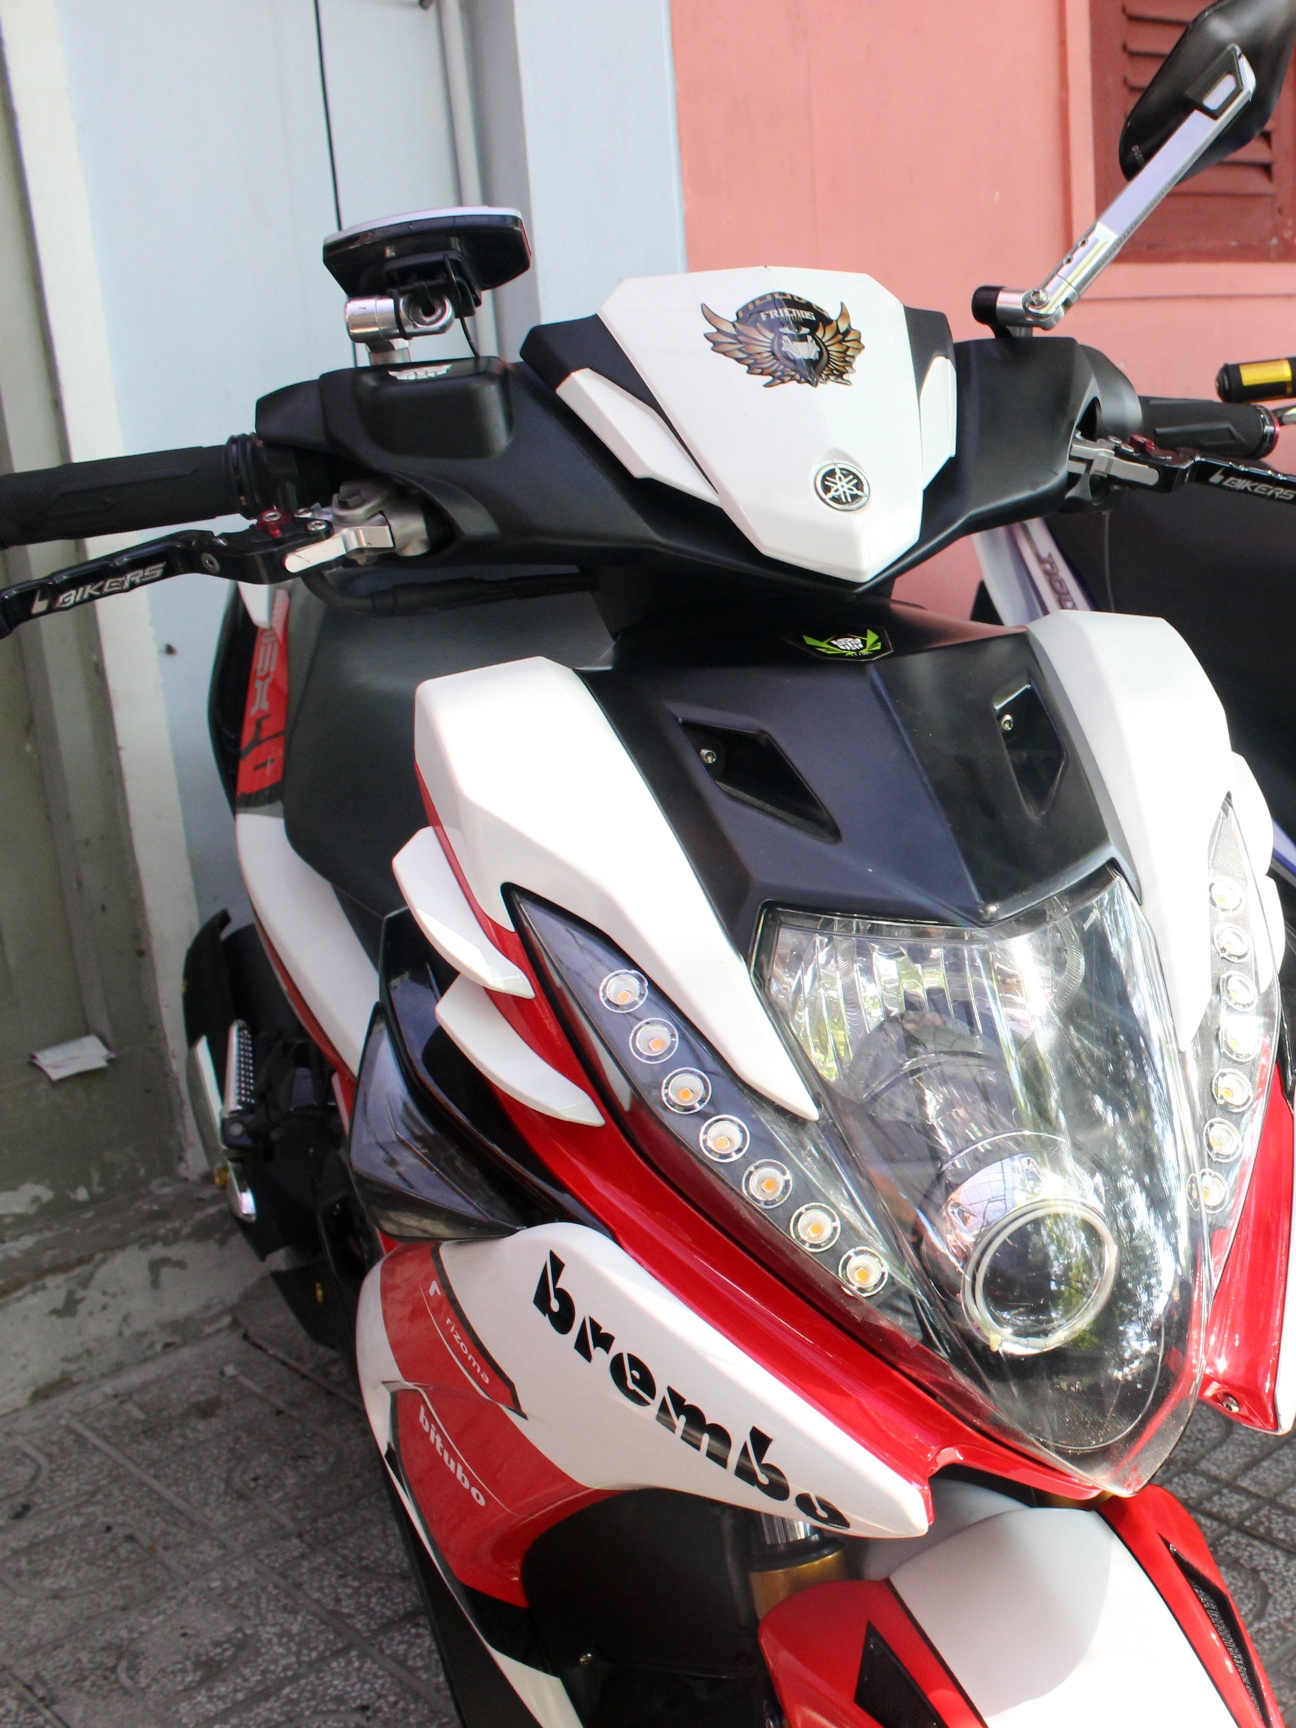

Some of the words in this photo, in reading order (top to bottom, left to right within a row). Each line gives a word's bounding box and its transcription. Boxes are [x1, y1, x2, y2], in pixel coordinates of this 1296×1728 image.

[53, 561, 167, 609] BIKERS
[446, 1318, 490, 1385] rizoma
[532, 1249, 851, 1530] brembo
[419, 1405, 486, 1507] bitubo
